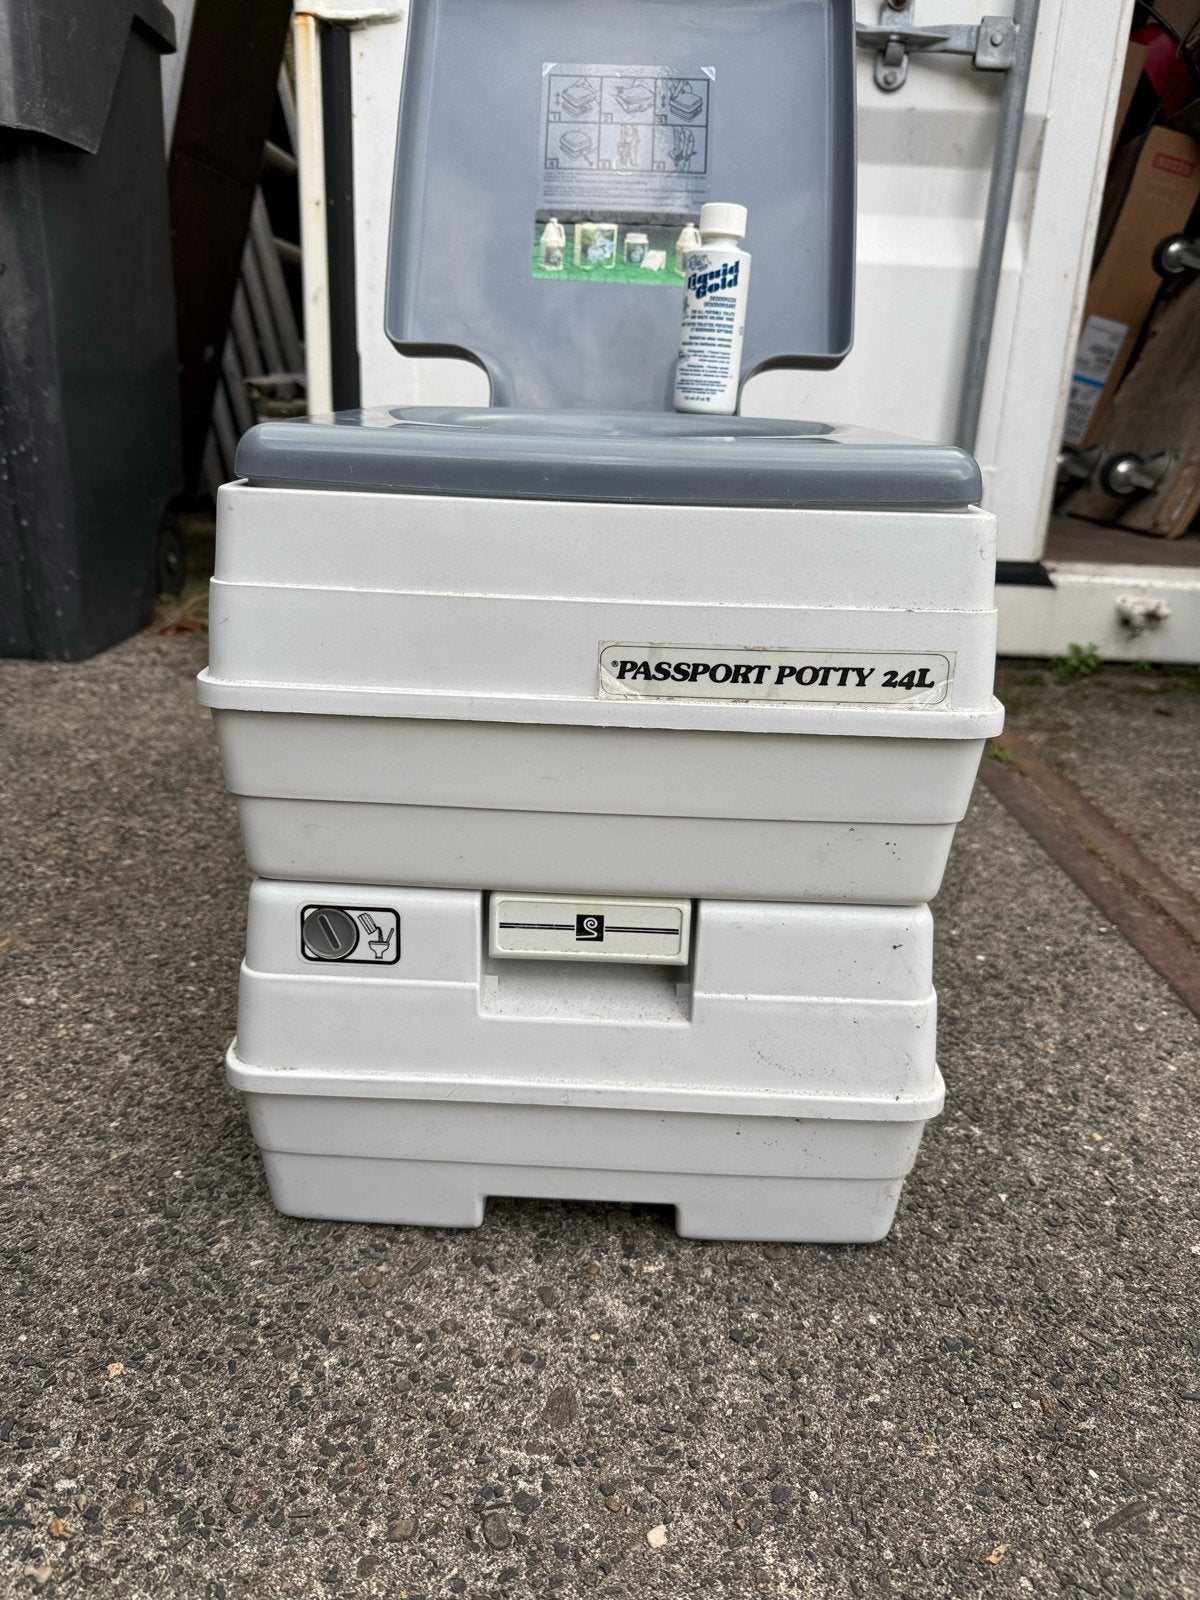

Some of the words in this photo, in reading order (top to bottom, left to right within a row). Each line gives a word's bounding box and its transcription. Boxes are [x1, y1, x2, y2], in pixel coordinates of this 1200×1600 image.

[688, 260, 740, 291] Liquid
[695, 274, 738, 299] Gold
[774, 665, 876, 687] POTTY
[881, 668, 935, 690] 24L
